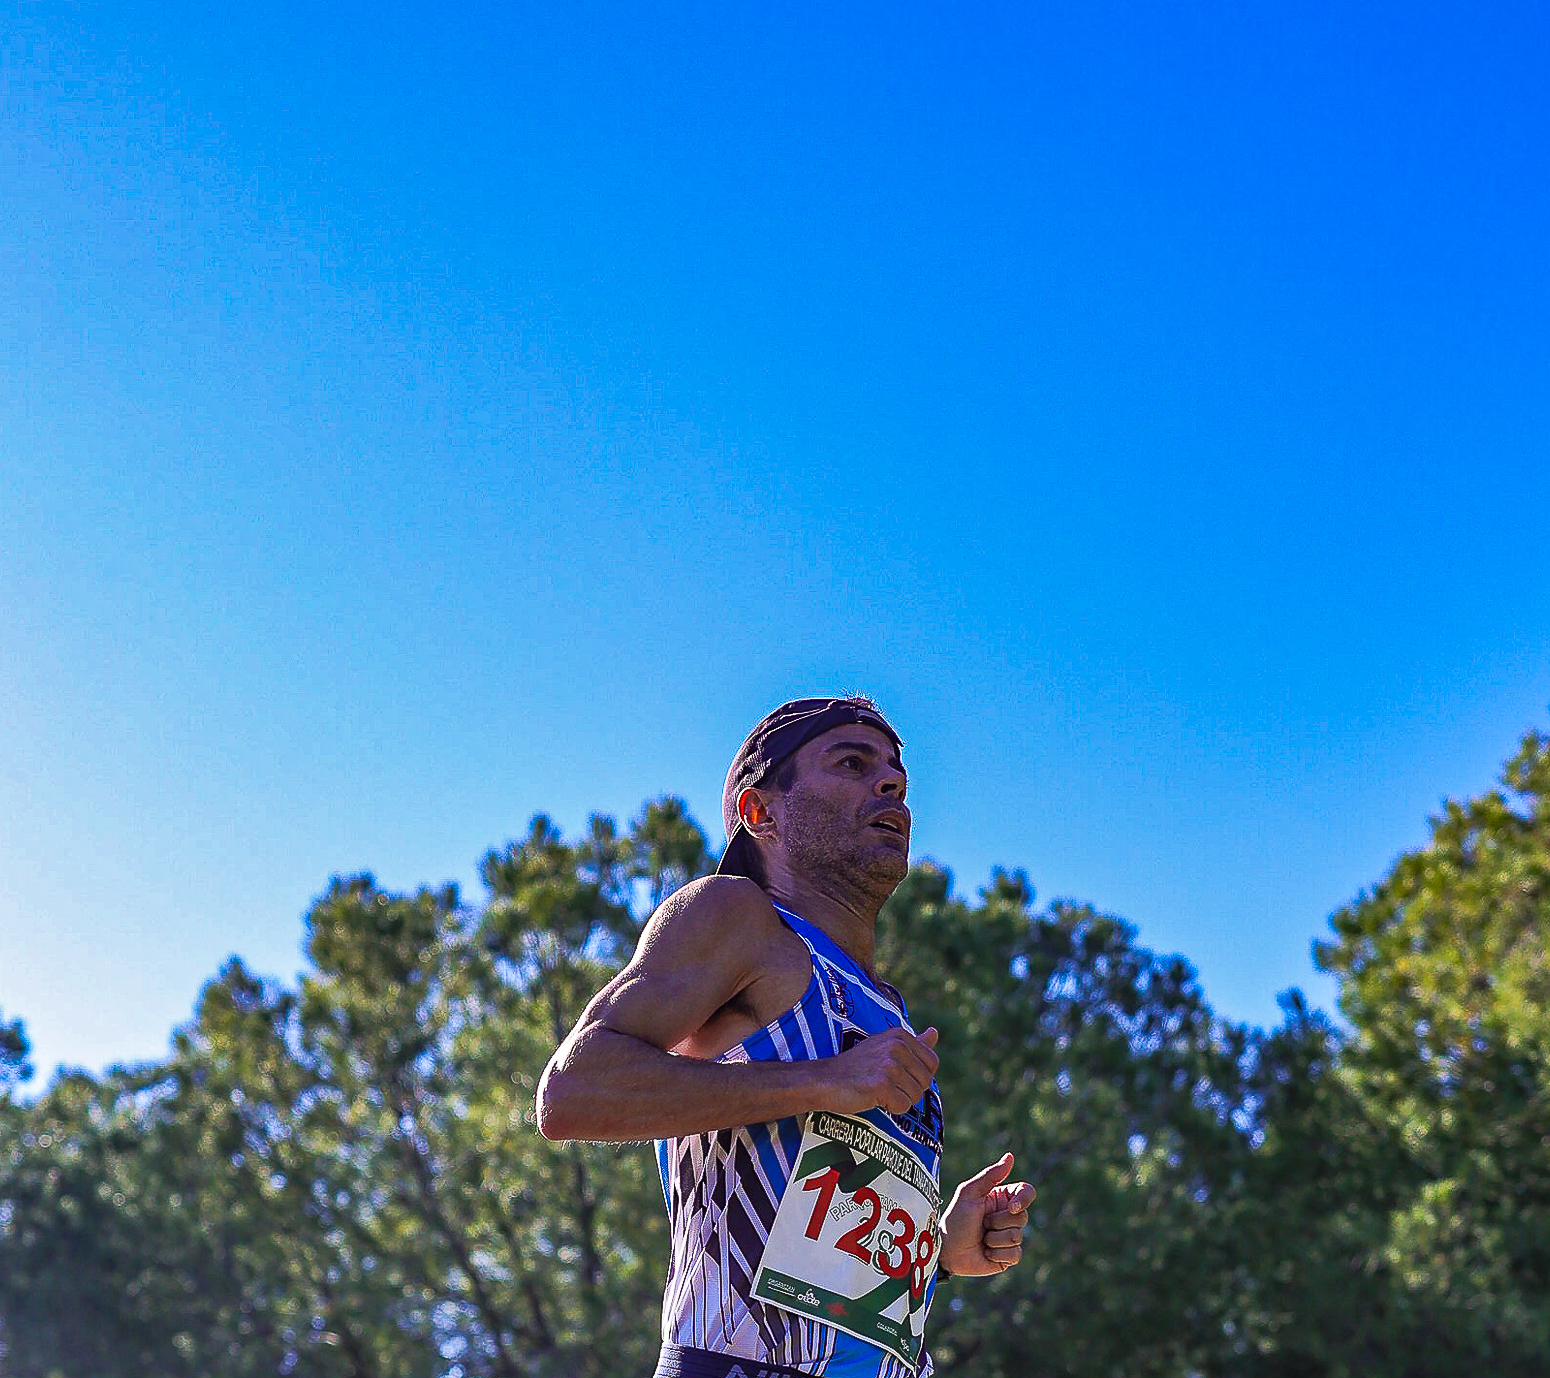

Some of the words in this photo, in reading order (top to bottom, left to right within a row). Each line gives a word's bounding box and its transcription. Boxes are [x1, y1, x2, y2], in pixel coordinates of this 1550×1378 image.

[818, 1115, 854, 1146] CARRERA
[854, 1127, 883, 1162] POPULAR
[803, 1168, 934, 1299] 1238
